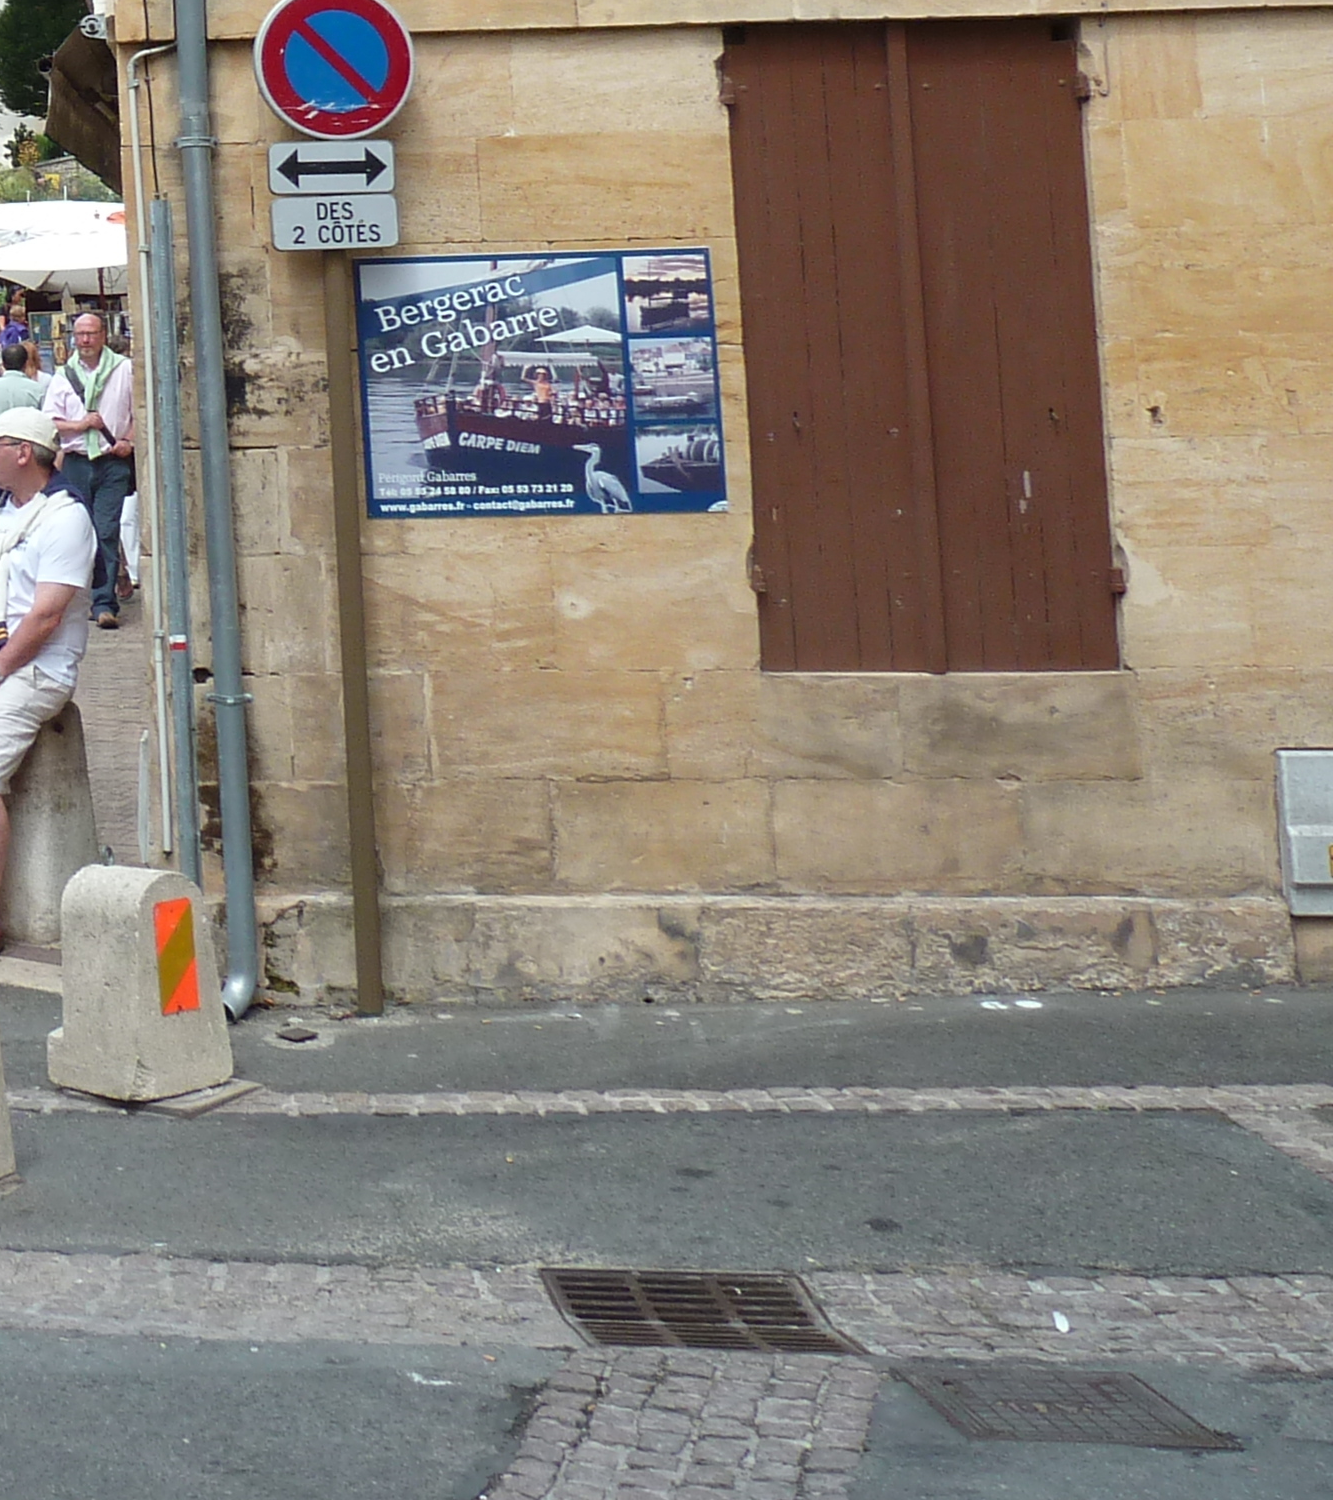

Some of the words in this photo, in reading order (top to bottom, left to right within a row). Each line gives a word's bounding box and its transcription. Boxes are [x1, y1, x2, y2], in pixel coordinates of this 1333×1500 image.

[316, 201, 354, 221] DES
[292, 225, 306, 245] 2
[317, 219, 382, 244] CÔTÉS
[373, 275, 526, 333] Bergerac
[370, 345, 416, 374] en
[420, 305, 560, 358] Gabarre
[458, 431, 504, 451] CARPE
[505, 438, 541, 455] DIEM
[427, 470, 477, 482] Gabarres
[379, 500, 466, 514] www.gabarres.fr
[473, 498, 575, 511] contact@gabarres.fr
